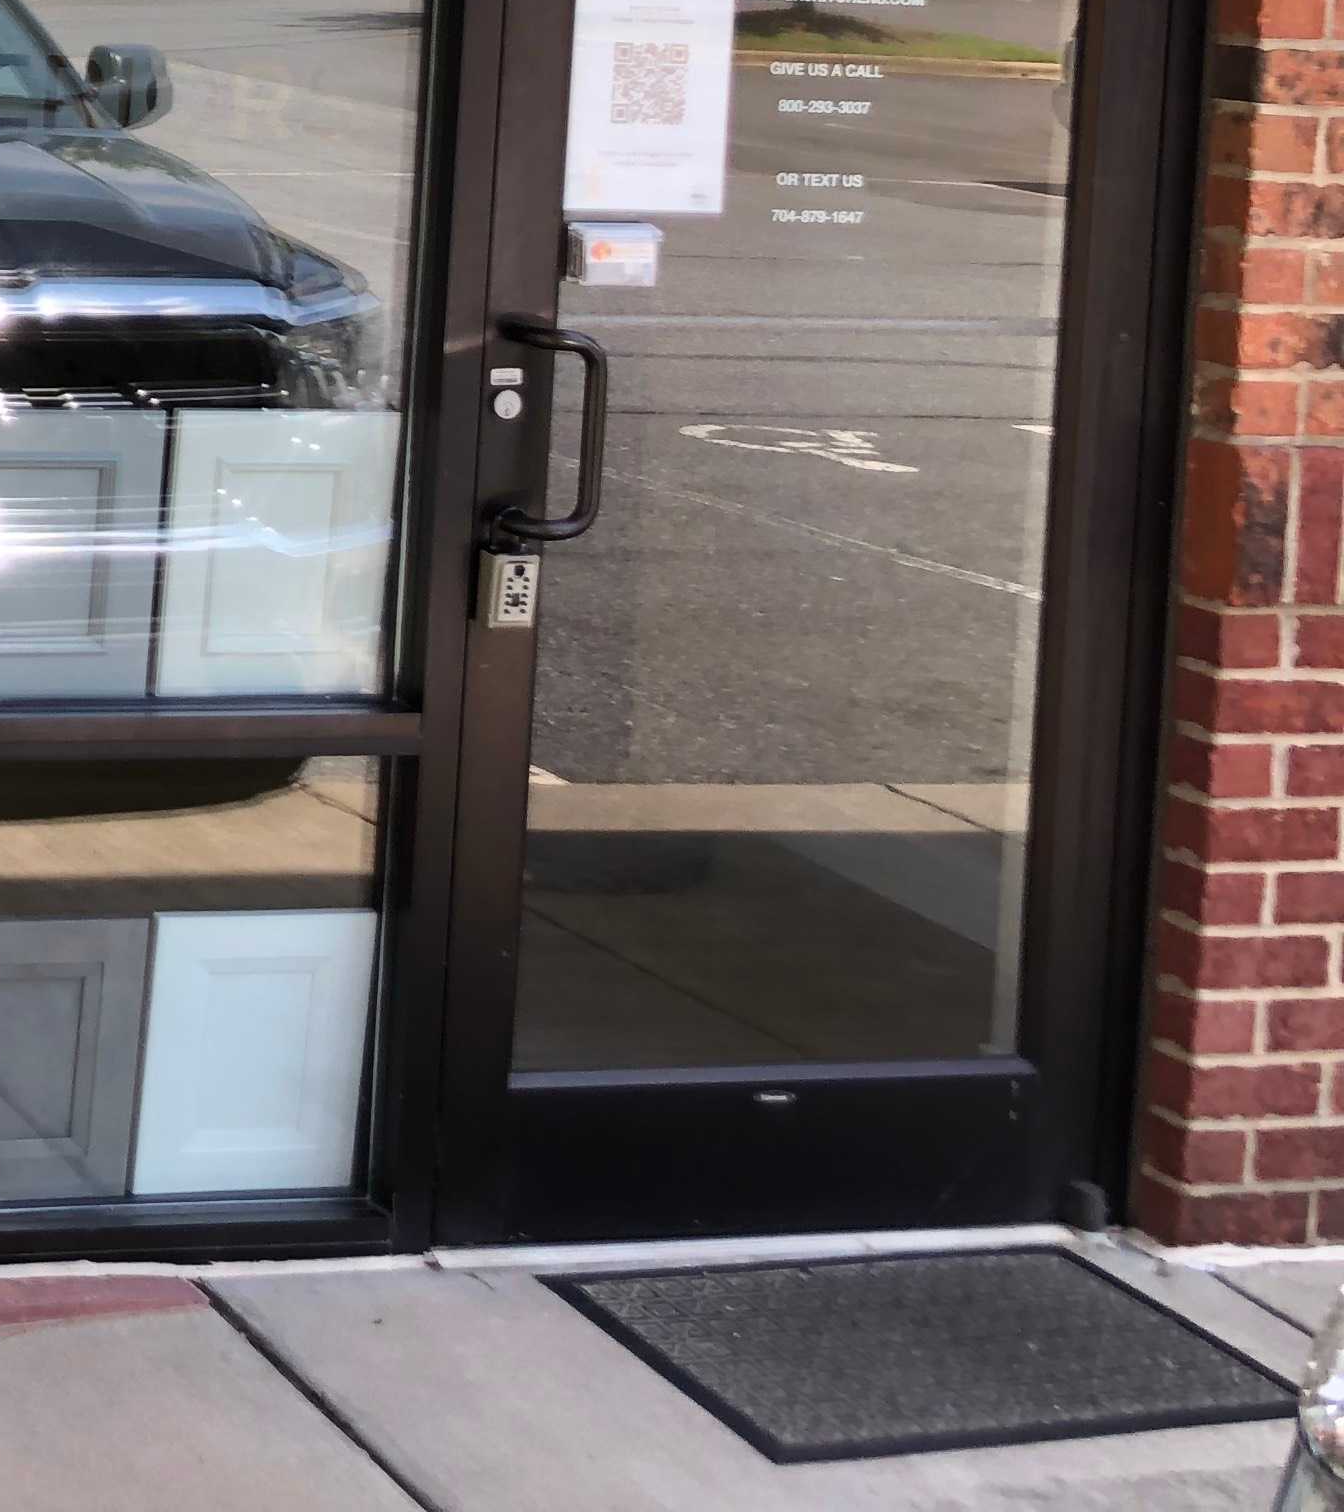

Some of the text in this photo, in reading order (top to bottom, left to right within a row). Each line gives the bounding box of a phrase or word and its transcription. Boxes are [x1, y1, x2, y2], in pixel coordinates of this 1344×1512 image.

[769, 61, 885, 79] GIVE US A CALL
[775, 172, 865, 188] OR TEXT US
